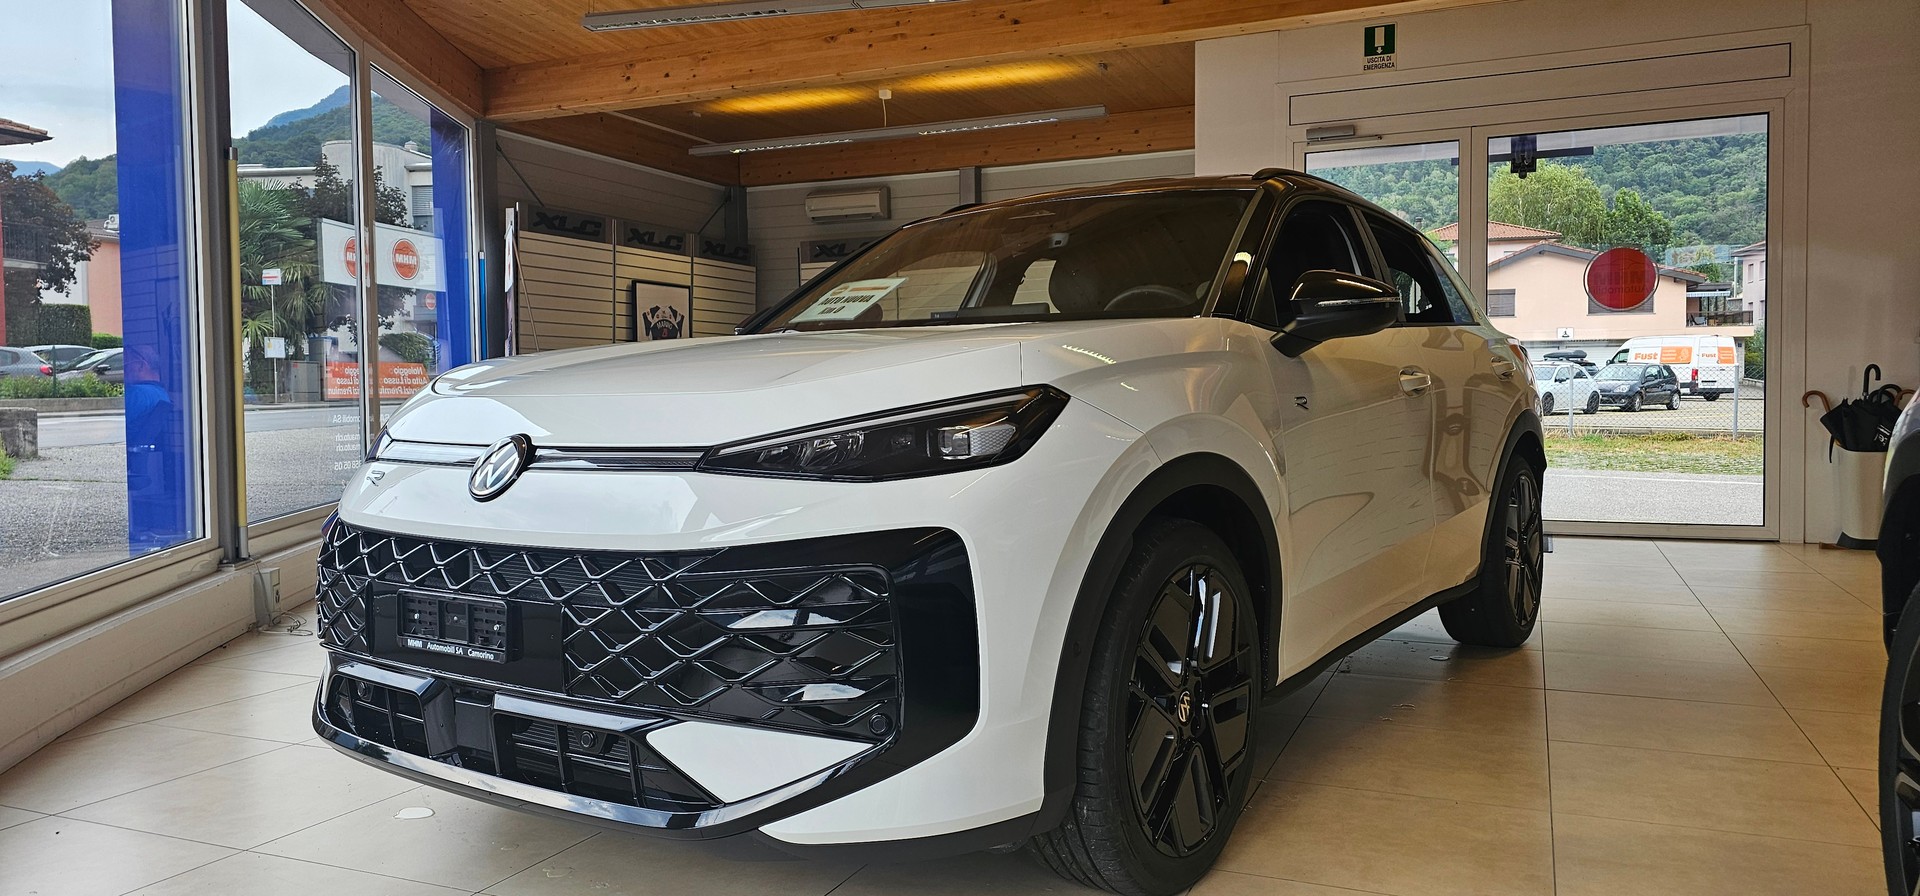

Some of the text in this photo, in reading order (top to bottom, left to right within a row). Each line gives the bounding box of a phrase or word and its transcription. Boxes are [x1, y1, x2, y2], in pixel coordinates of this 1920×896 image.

[1363, 62, 1395, 70] EMERGENZA
[532, 211, 602, 237] XLC
[627, 228, 684, 251] XLC
[1634, 352, 1658, 360] Fust
[407, 638, 494, 660] MHM Automobili SA Camorino
